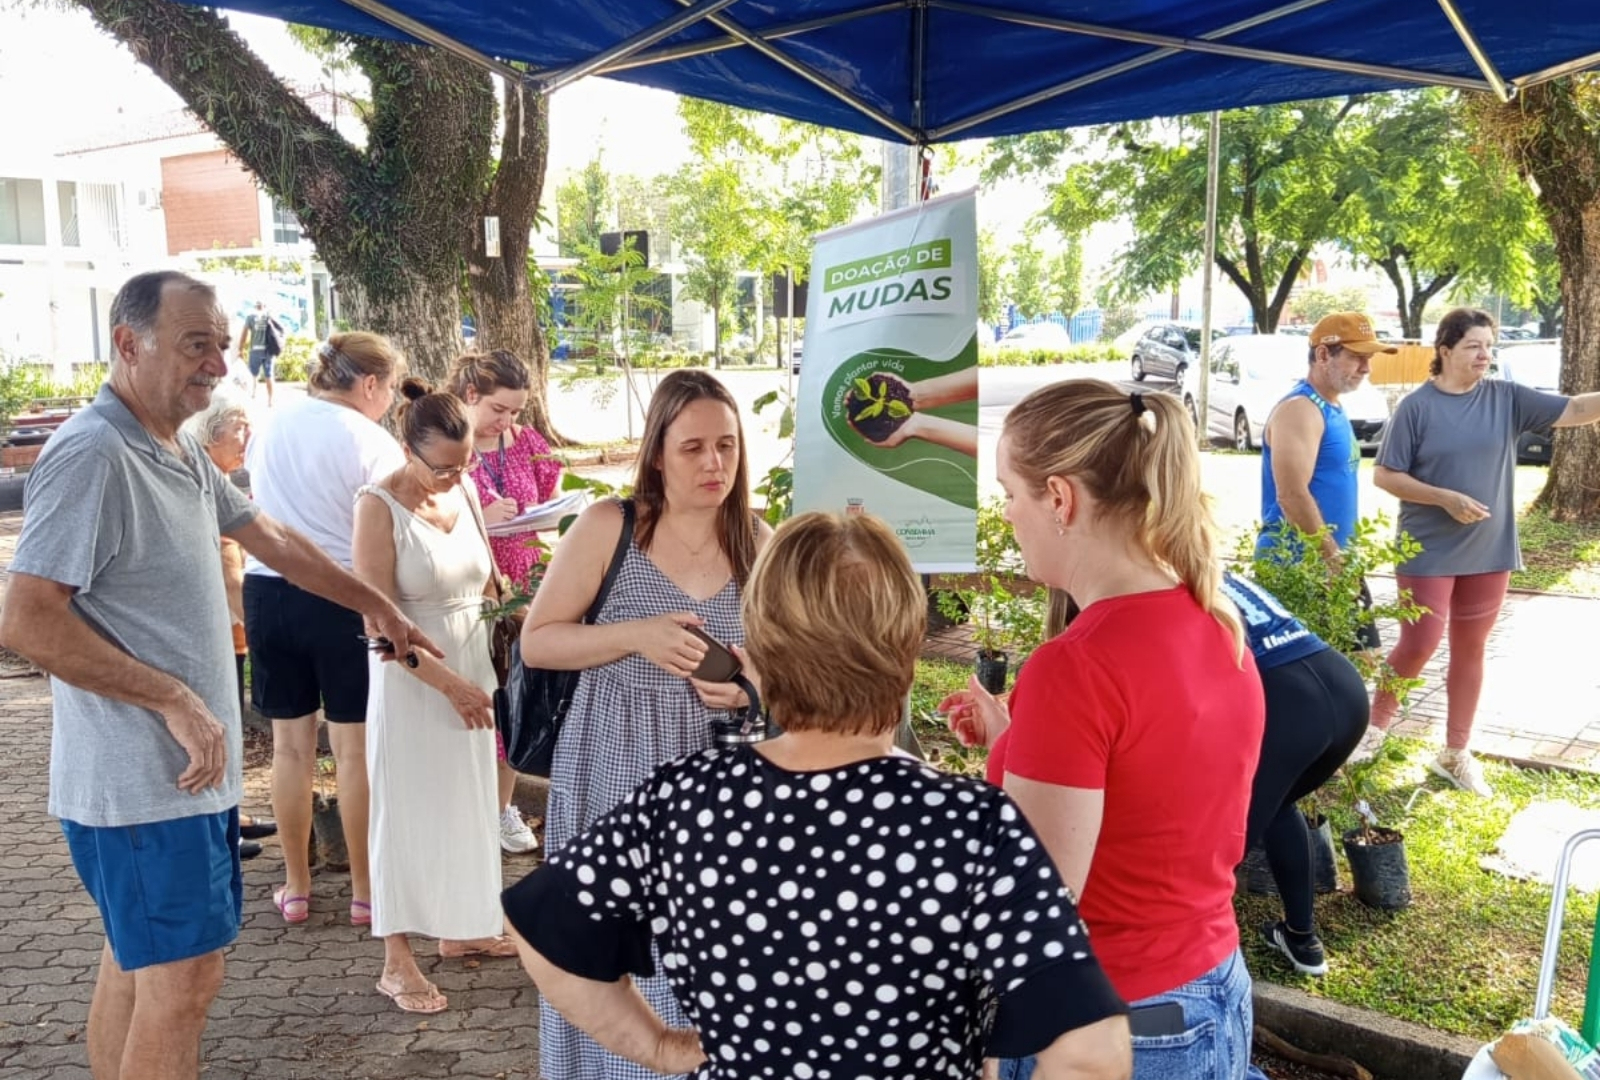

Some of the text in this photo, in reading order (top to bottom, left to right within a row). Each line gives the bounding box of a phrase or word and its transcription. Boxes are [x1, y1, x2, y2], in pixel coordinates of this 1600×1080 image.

[831, 247, 943, 285] DOAÇÃO DE
[828, 276, 952, 318] MUDAS
[832, 359, 905, 419] Vamos plantar vida
